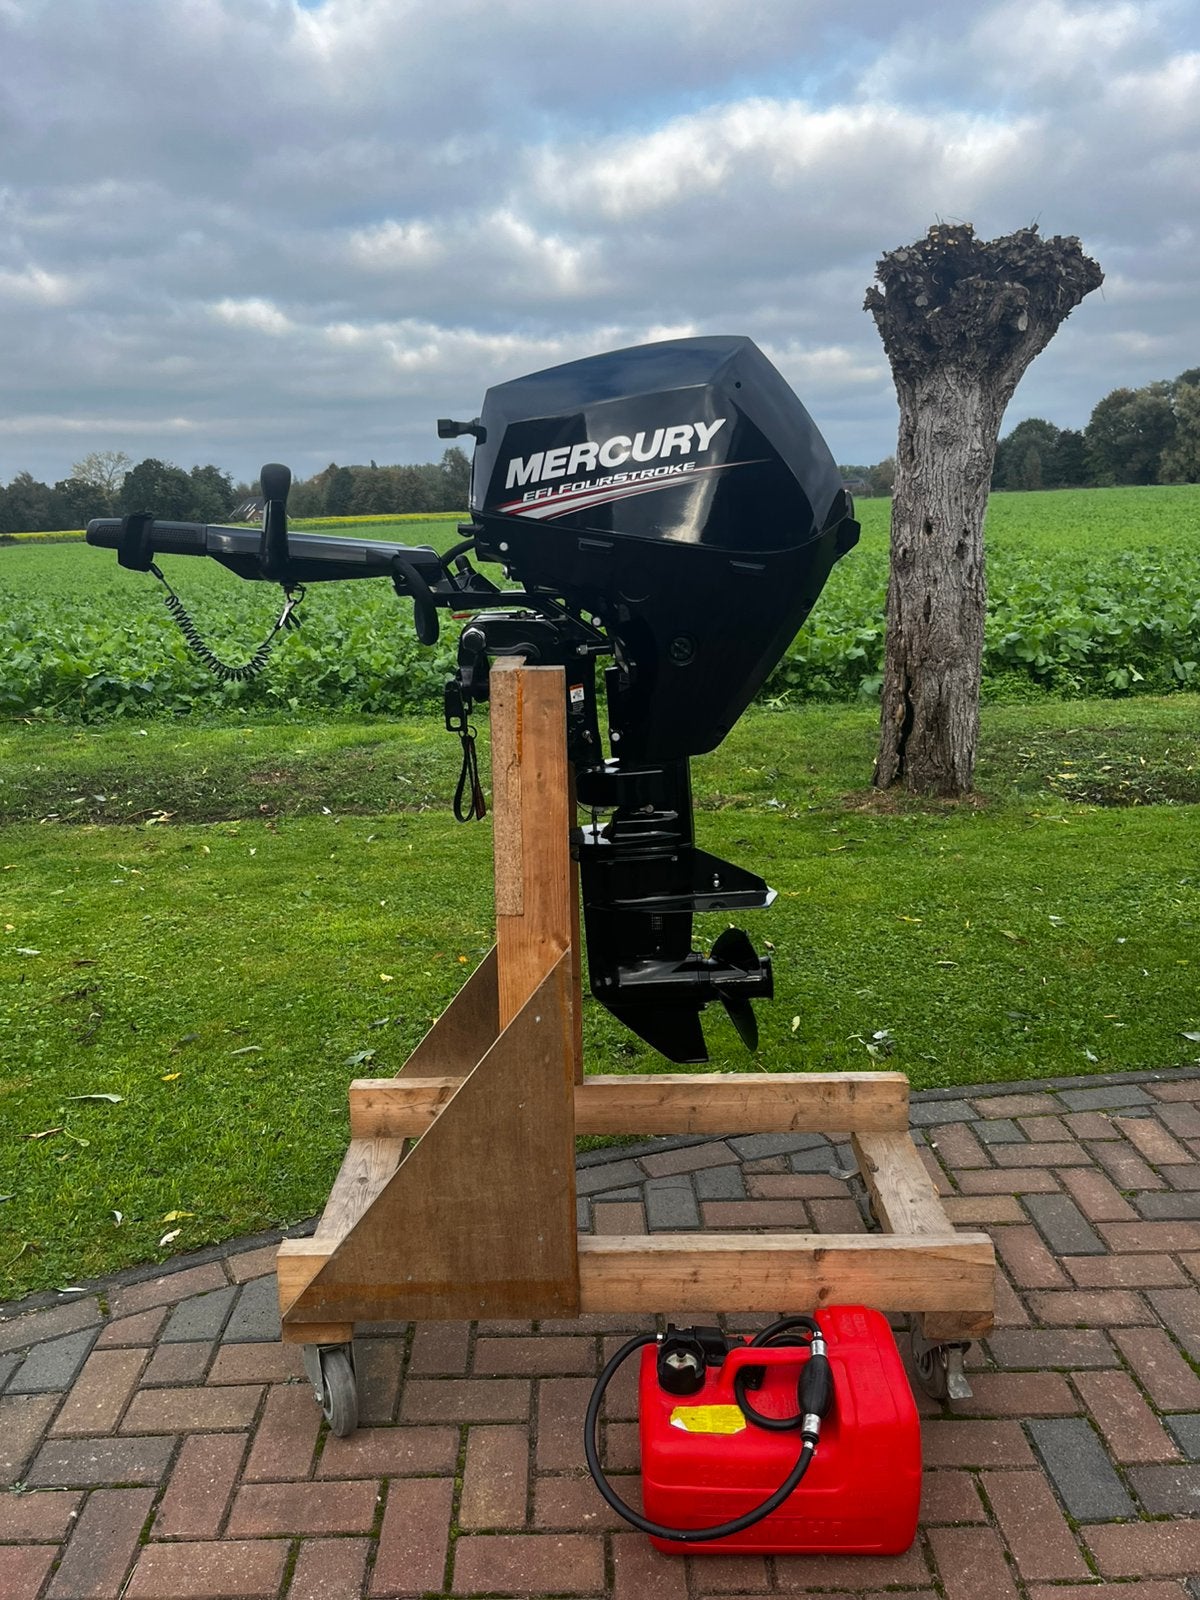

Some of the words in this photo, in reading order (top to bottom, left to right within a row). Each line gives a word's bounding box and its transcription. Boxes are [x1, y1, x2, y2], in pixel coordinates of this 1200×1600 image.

[505, 418, 727, 489] MERCURY
[522, 487, 552, 502] EFI
[558, 461, 696, 494] FOURSTROKE
